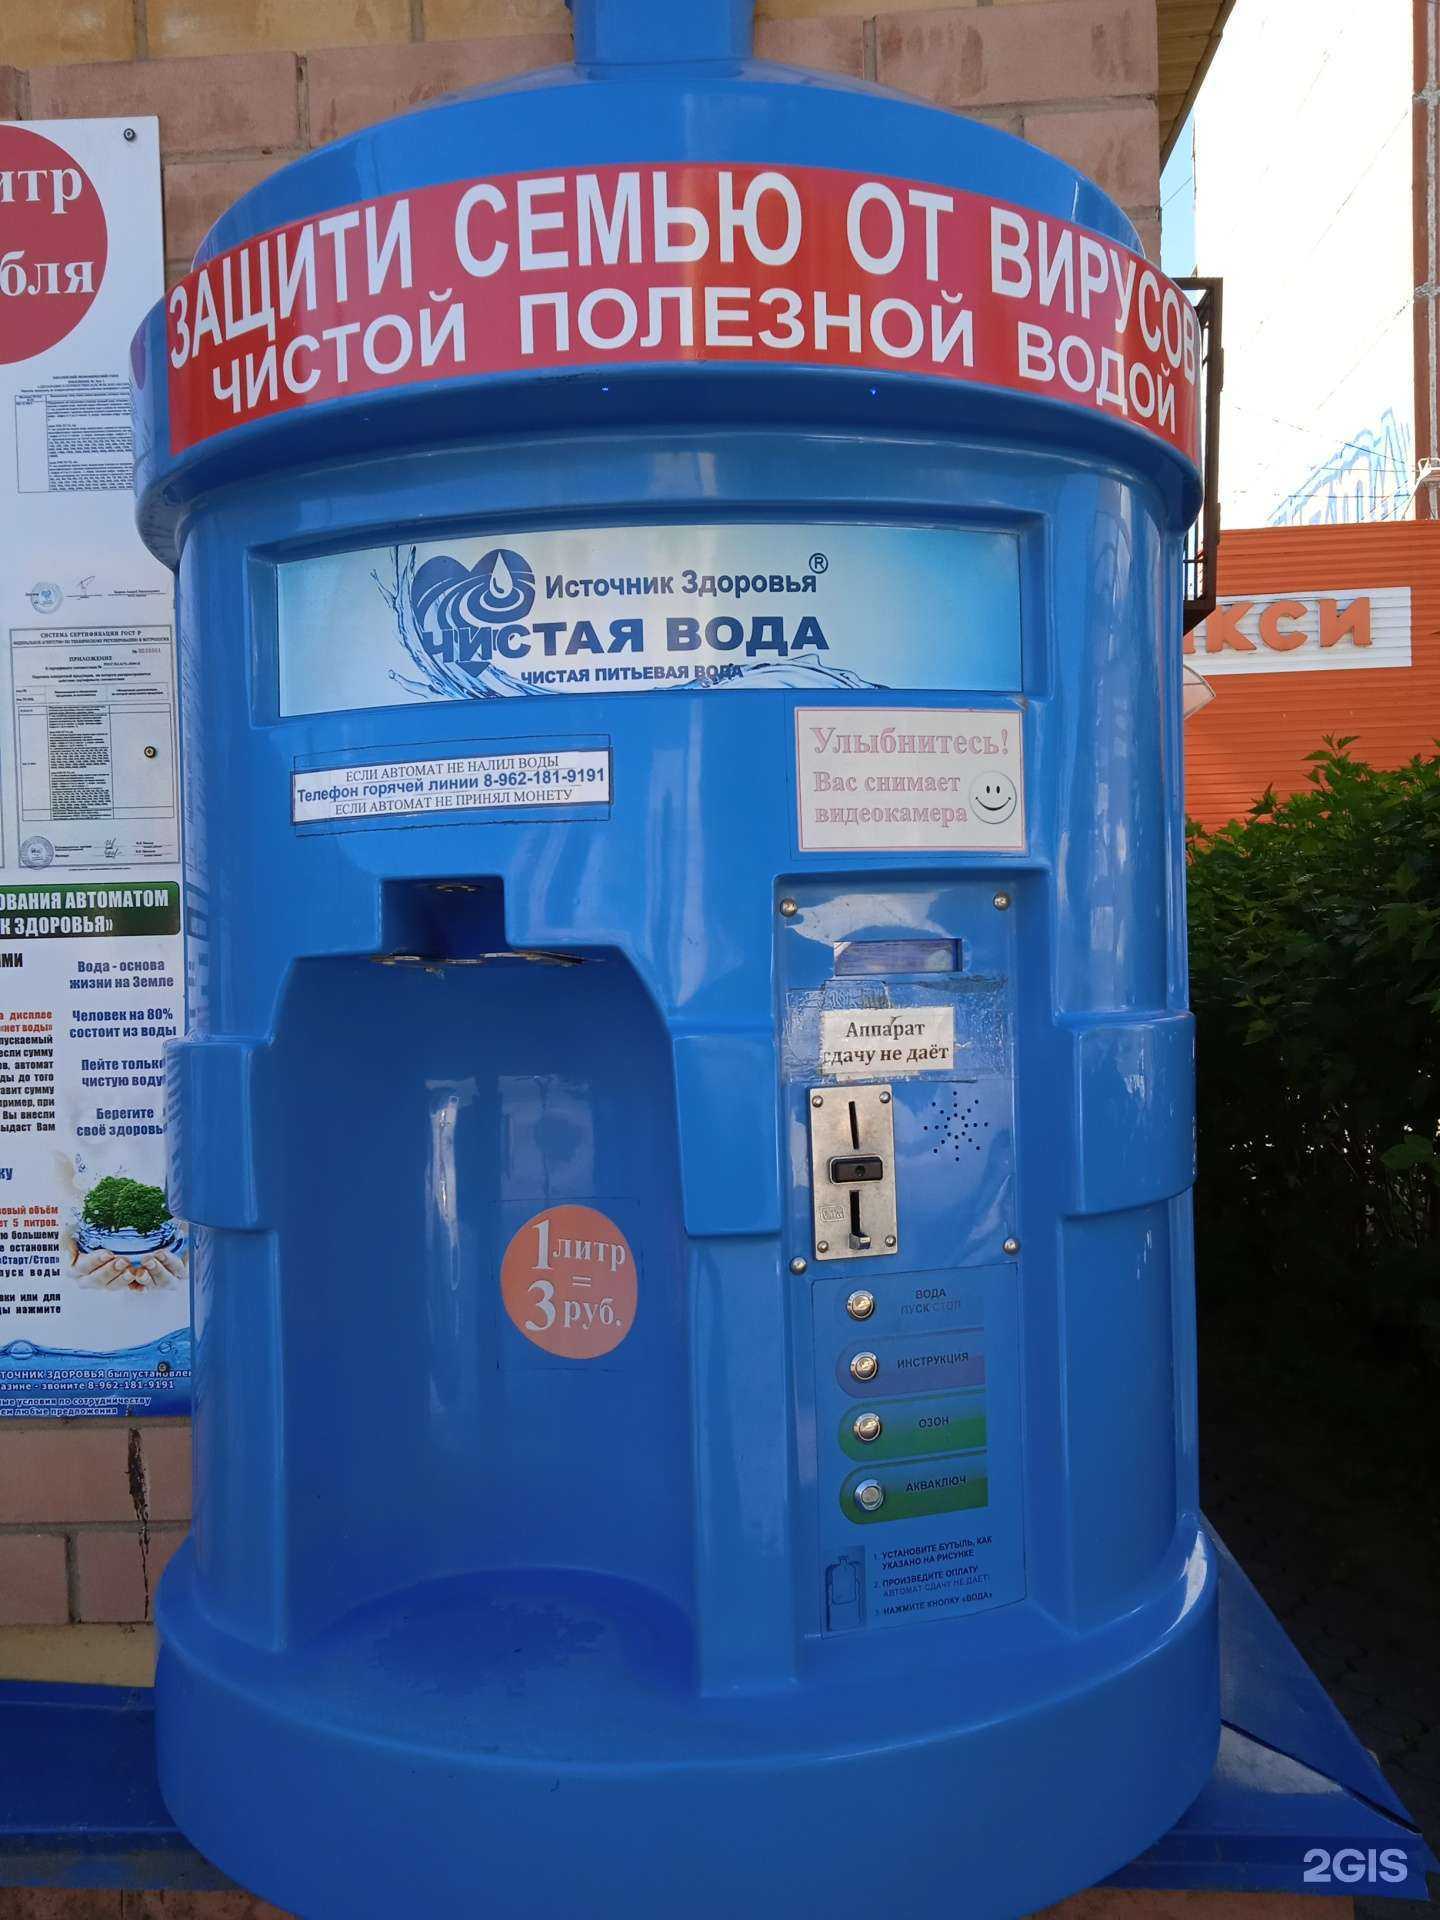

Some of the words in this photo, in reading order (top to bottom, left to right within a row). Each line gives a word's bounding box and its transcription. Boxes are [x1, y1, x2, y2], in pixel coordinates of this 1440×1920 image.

[168, 199, 412, 369] ЗАЩИТИ
[455, 170, 802, 278] СЕМЬЮ
[846, 182, 954, 281] ОТ
[990, 206, 1201, 386] ВИРУСОВ
[212, 288, 466, 413] ЧИСТОЙ
[520, 286, 974, 368] ПОЛЕЗНОЙ
[1018, 320, 1176, 434] ВОДОЙ
[545, 573, 674, 600] Источник
[681, 570, 817, 598] Здоровья
[1183, 597, 1373, 654] КСИ
[422, 616, 644, 664] ЧИСТАЯ
[666, 615, 830, 657] ВОДА
[521, 668, 588, 685] ЧИСТАЯ
[594, 665, 691, 682] ПИТЬЕВАЯ
[809, 726, 1009, 755] Улыбнитесь!
[346, 769, 379, 783] ЕСЛИ
[381, 765, 445, 781] АВТОМАТ
[447, 762, 466, 774] НЕ
[468, 759, 516, 773] НАЛИЛ
[518, 755, 560, 769] ВОДЫ
[297, 786, 358, 803] Телефон
[363, 780, 425, 798] горячей
[428, 777, 479, 792] линии
[483, 768, 606, 789] 8-962-181-9191
[813, 771, 858, 792] Вас
[864, 776, 961, 792] снимает
[335, 804, 368, 816] ЕСЛИ
[370, 797, 433, 813] АВТОМАТ
[435, 795, 454, 808] НЕ
[456, 793, 511, 808] ПРИНЯЛ
[513, 788, 573, 803] МОНЕТУ
[815, 806, 969, 828] видеокамера
[65, 890, 168, 909] АВТОМАТОМ
[14, 916, 113, 937] ЗДОРОВЬЯ»
[78, 961, 110, 974] Вода
[120, 960, 165, 972] основа
[70, 977, 112, 989] жизни
[115, 978, 130, 988] на
[133, 976, 174, 987] Земле
[10, 1011, 52, 1020] дисплее
[73, 1009, 127, 1021] Человек
[129, 1010, 144, 1021] на
[147, 1008, 173, 1020] 80%
[70, 1027, 120, 1038] состоит
[123, 1027, 138, 1037] из
[141, 1026, 176, 1038] воды
[846, 1021, 926, 1041] Аппарат
[23, 1049, 53, 1058] сумму
[880, 1048, 903, 1061] не
[906, 1044, 950, 1063] даёт
[14, 1061, 54, 1070] автомат
[82, 1058, 119, 1071] Пейте
[18, 1074, 30, 1083] до
[82, 1076, 129, 1088] чистую
[132, 1075, 163, 1088] воду
[24, 1086, 54, 1095] сумму
[37, 1099, 55, 1107] при
[3, 1111, 17, 1120] Вы
[20, 1111, 55, 1119] внесли
[96, 1108, 154, 1121] Берегите
[37, 1122, 56, 1131] Вам
[76, 1124, 106, 1137] своё
[13, 1218, 19, 1228] 5
[11, 1231, 59, 1240] большему
[10, 1243, 59, 1252] остановки
[532, 1219, 552, 1270] 1
[552, 1239, 626, 1272] литр
[30, 1268, 60, 1278] воды
[21, 1293, 38, 1302] или
[915, 1288, 946, 1299] ВОДА
[16, 1306, 61, 1314] нажмите
[525, 1279, 556, 1331] 3
[564, 1298, 622, 1330] руб.
[897, 1352, 969, 1369] ИНСТРУКЦИЯ
[47, 1370, 104, 1380] ЗДОРОВЬЯ
[107, 1369, 129, 1378] был
[41, 1382, 85, 1390] звоните
[87, 1380, 174, 1390] 8-962-181-9191
[918, 1416, 950, 1429] ОЗОН
[905, 1475, 967, 1492] АКВАКЛЮЧ
[882, 1544, 937, 1560] УСТАНОВИТЕ
[881, 1557, 922, 1571] УКАЗАНО
[923, 1555, 935, 1564] НА
[882, 1570, 944, 1588] ПРОИЗВЕДИТЕ
